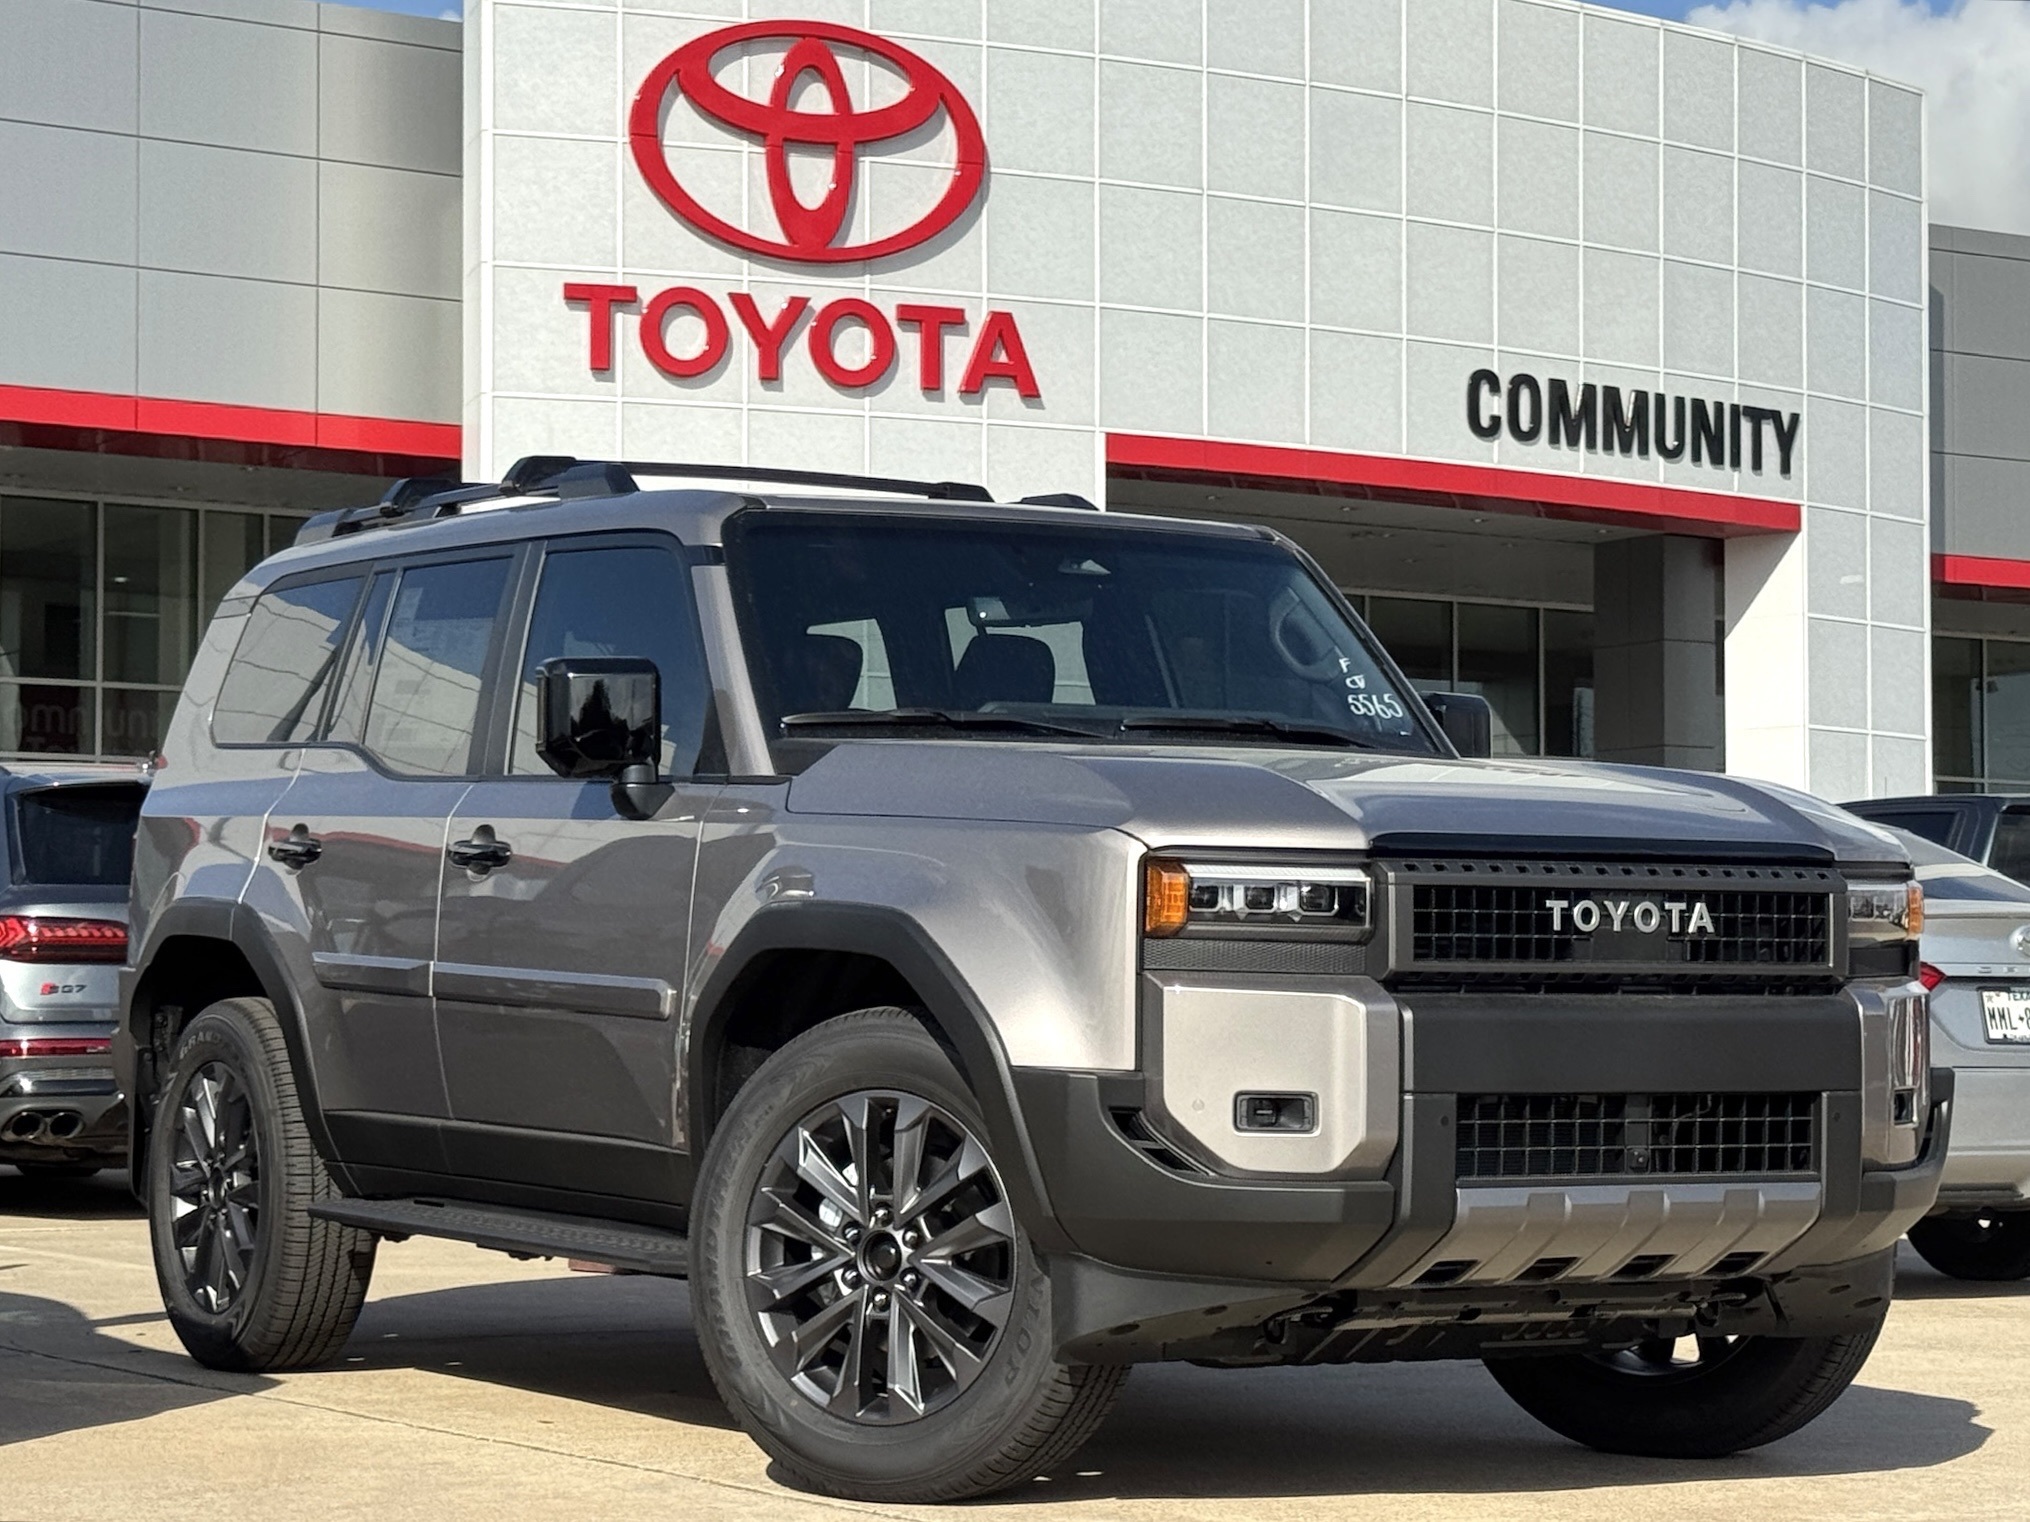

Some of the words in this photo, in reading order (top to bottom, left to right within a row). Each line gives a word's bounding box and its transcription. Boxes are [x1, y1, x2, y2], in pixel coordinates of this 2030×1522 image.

[563, 283, 1041, 398] TOYOTA
[1466, 368, 1801, 477] COMMUNITY
[1338, 656, 1351, 673] F
[1546, 899, 1715, 934] TOYOTA
